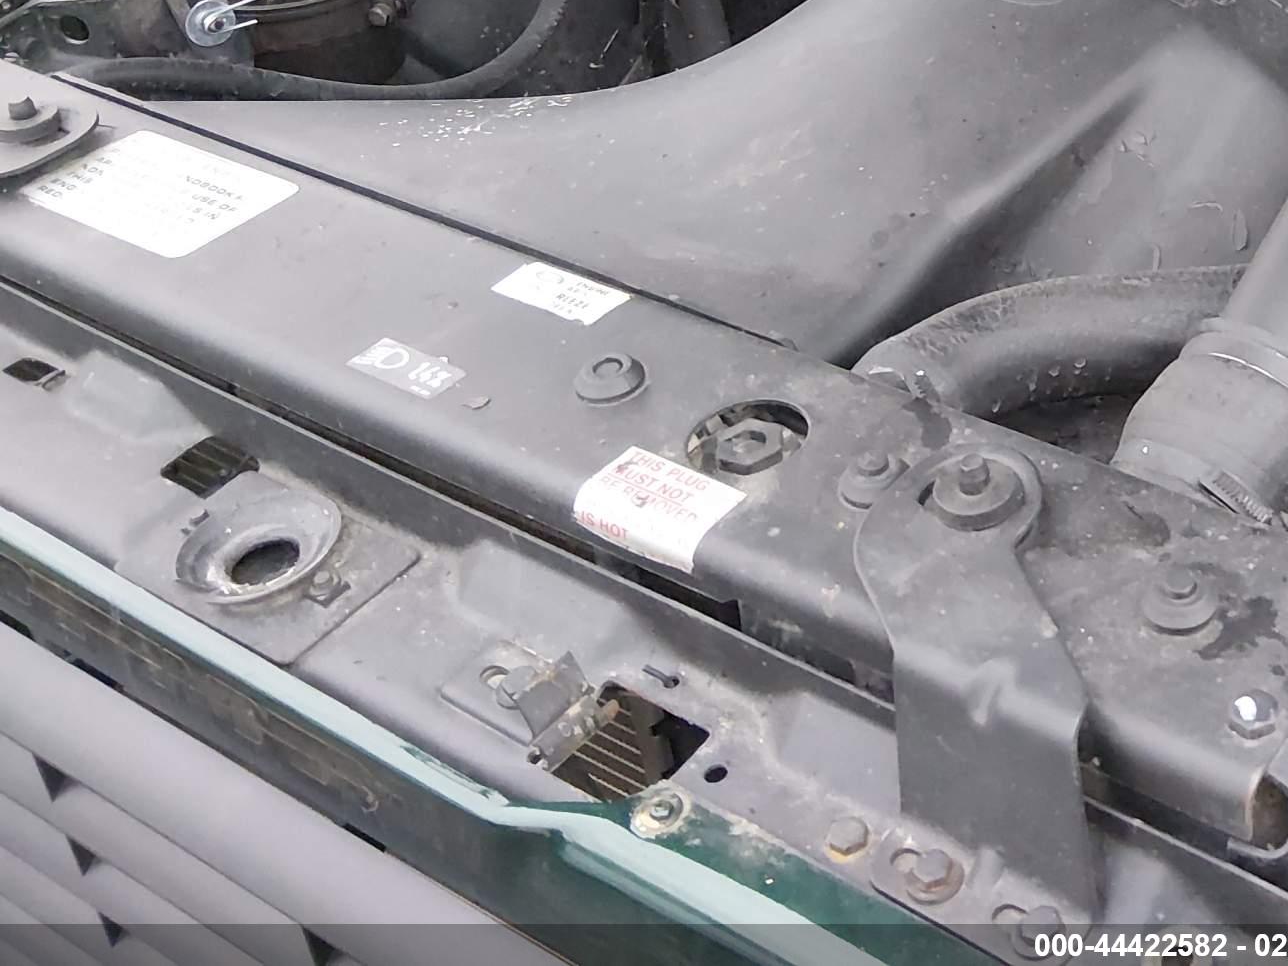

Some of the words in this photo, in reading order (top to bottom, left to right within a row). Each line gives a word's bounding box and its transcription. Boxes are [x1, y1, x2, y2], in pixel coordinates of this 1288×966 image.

[630, 450, 666, 474] THIS
[668, 467, 710, 492] PLUG
[657, 482, 695, 503] NOT
[580, 510, 595, 527] IS
[599, 517, 629, 540] HOT
